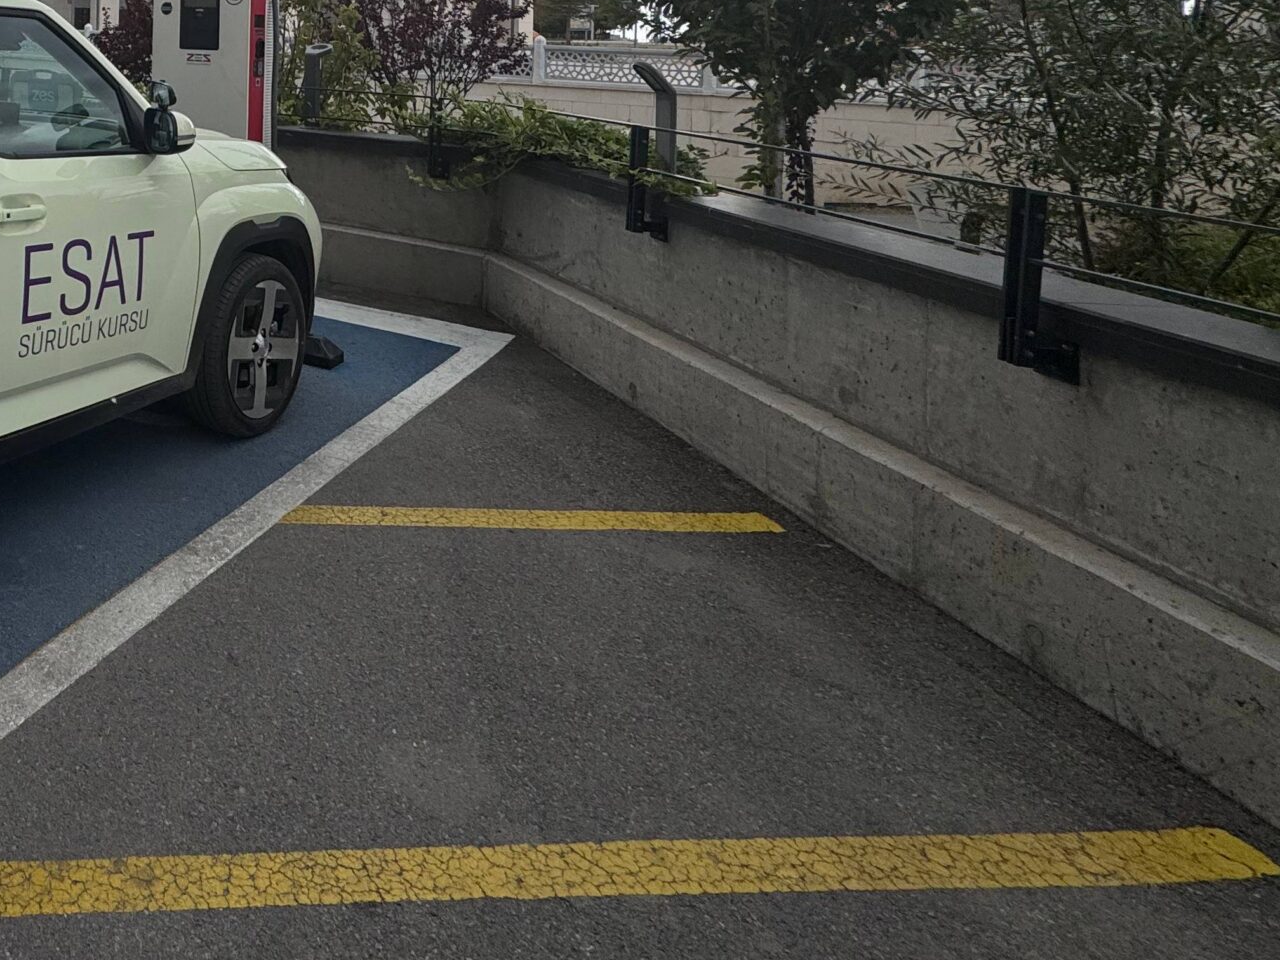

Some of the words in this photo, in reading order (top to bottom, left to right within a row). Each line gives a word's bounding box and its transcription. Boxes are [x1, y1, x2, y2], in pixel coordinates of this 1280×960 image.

[21, 230, 155, 325] ESAT
[18, 315, 93, 358] SÜRÜCÜ
[96, 308, 149, 341] KURSU
